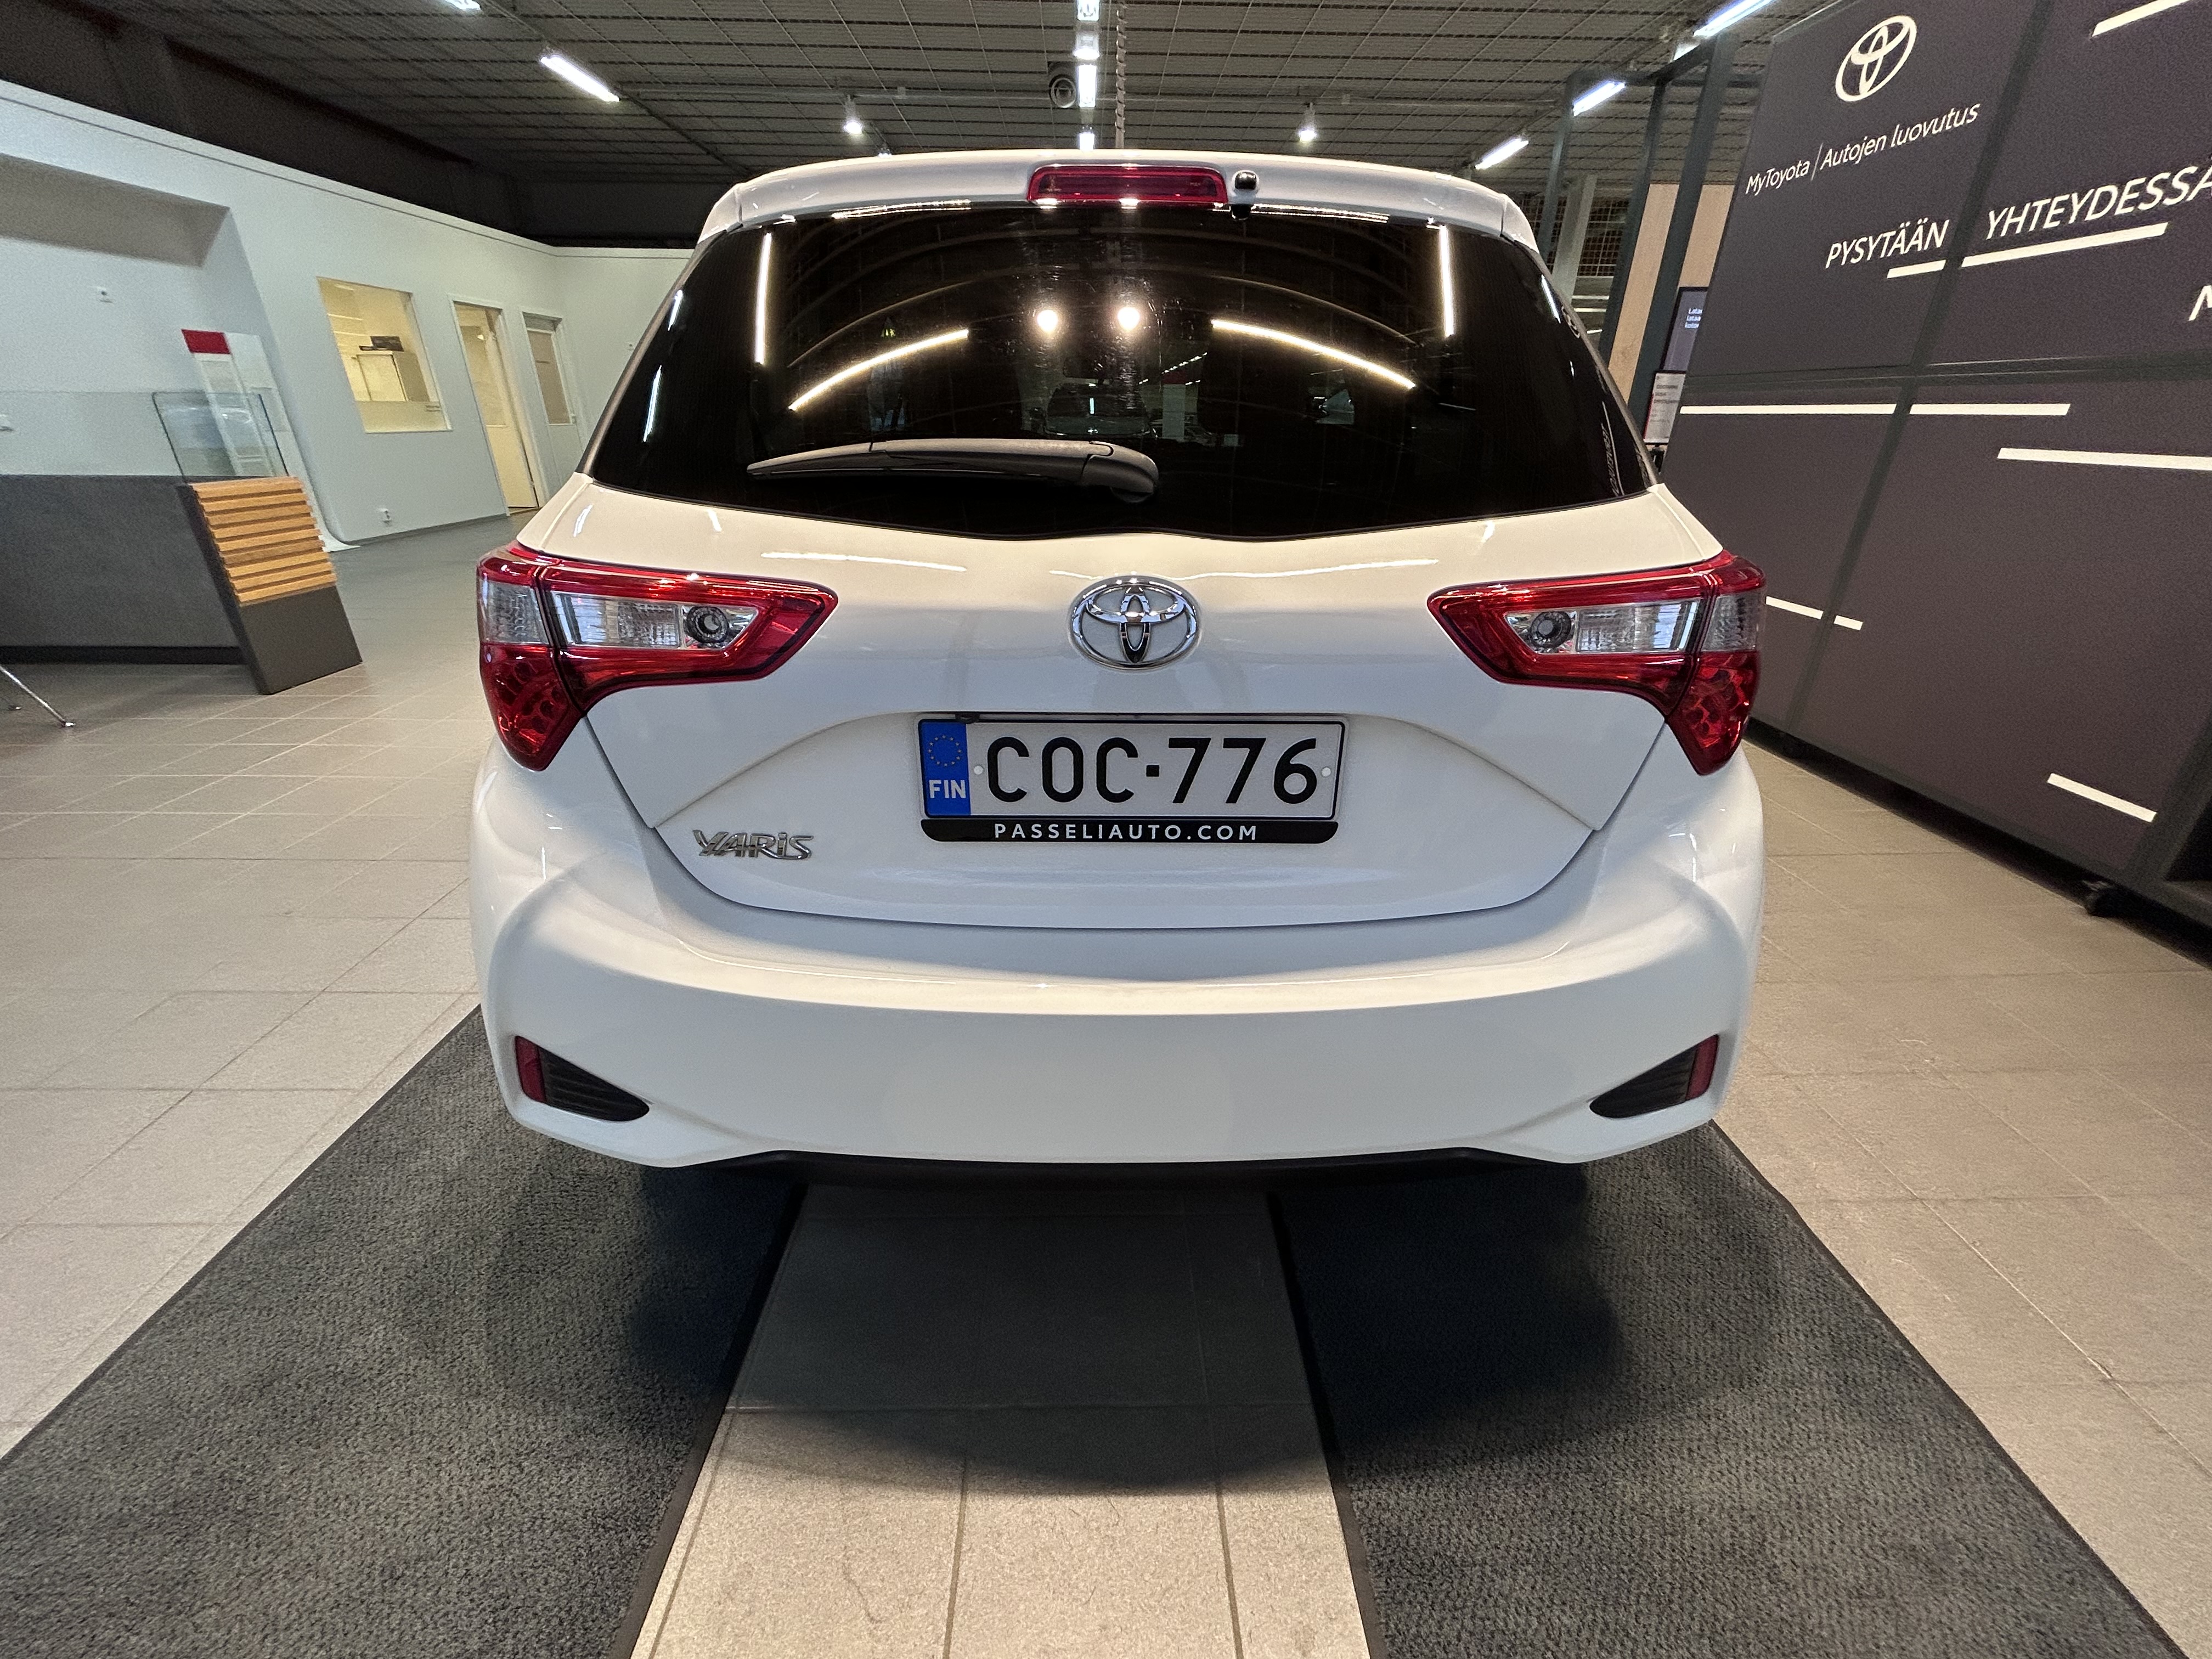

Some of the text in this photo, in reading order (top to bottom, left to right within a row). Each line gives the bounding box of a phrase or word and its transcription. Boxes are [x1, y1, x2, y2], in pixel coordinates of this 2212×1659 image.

[1745, 103, 1980, 196] MyToyota Autojen luovutus
[1825, 217, 1950, 269] PYSYTÄÄN
[929, 780, 967, 799] FIN
[995, 823, 1257, 840] PASSELIAUTO.COM
